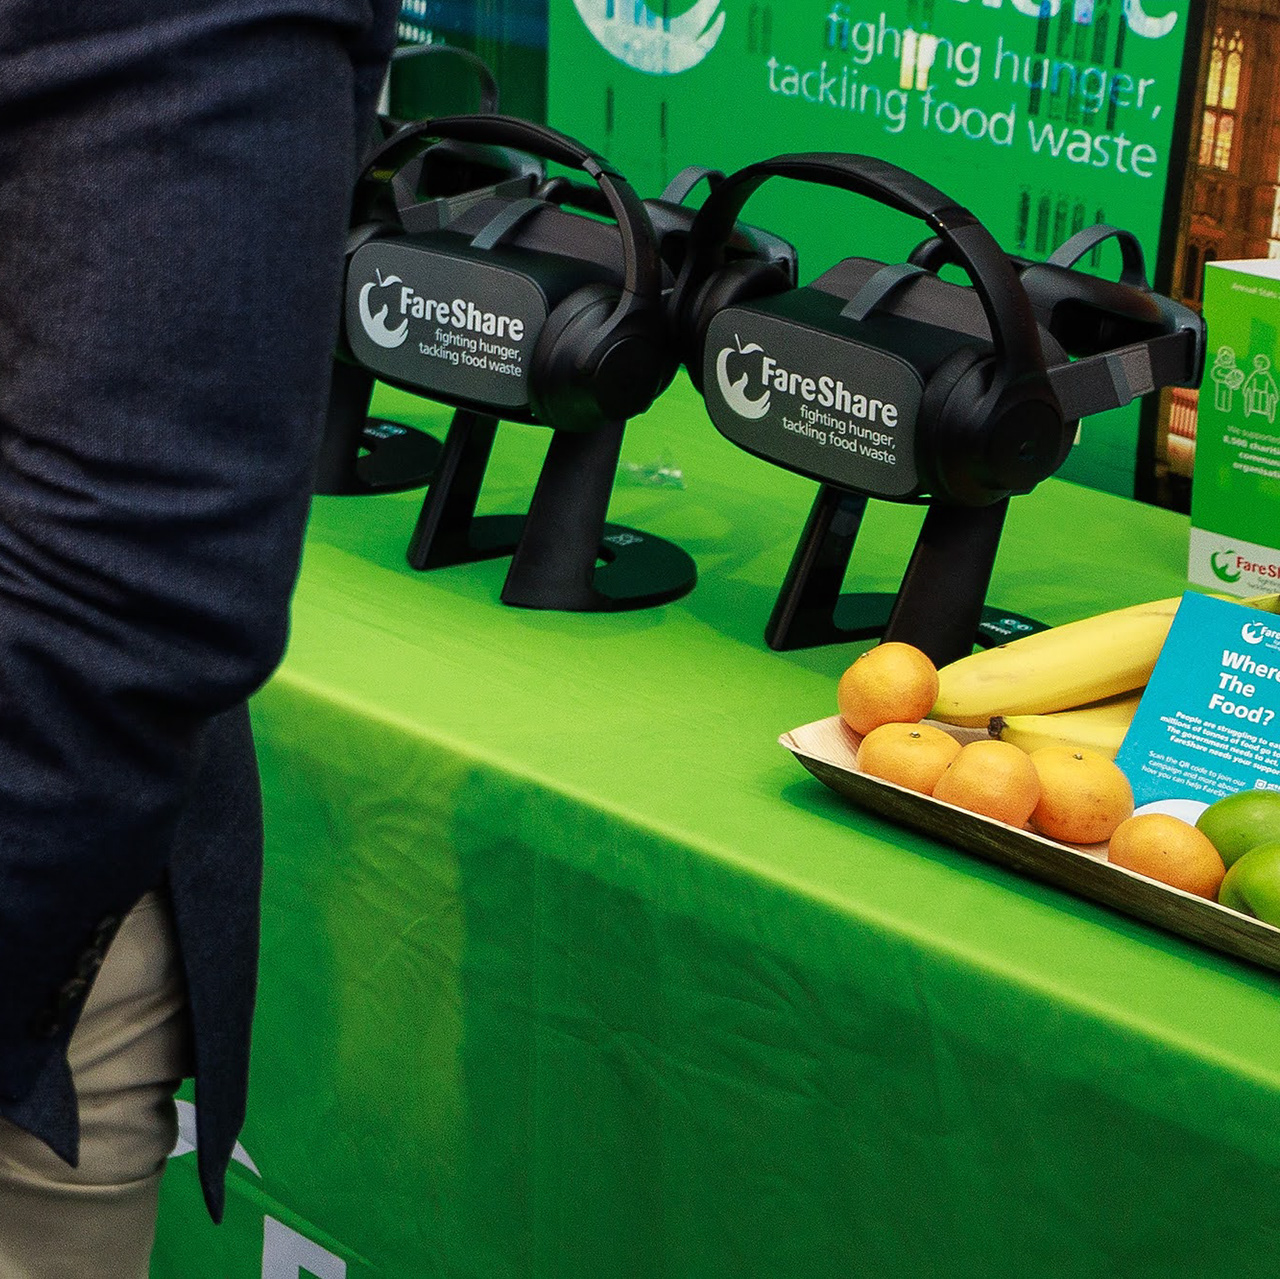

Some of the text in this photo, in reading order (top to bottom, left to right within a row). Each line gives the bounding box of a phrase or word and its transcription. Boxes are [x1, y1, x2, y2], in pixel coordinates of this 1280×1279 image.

[995, 37, 1162, 119] hunger,
[767, 55, 1157, 179] tackling food waste
[400, 286, 524, 341] FareShare
[419, 342, 522, 377] tackling food waste
[435, 328, 522, 362] fighting hunger,
[761, 356, 898, 427] FareShare
[782, 416, 896, 465] tackling food waste
[800, 404, 897, 449] fighting hunger,
[1219, 672, 1255, 698] The
[1208, 693, 1275, 726] Food?
[1160, 715, 1191, 730] millions
[1192, 723, 1202, 733] of
[1202, 728, 1229, 742] tonnes
[1229, 737, 1240, 745] of
[1240, 739, 1260, 752] food
[1260, 746, 1271, 756] go
[1166, 725, 1279, 767] The government needs to act.
[1175, 711, 1202, 725] People
[1203, 719, 1216, 729] are
[1217, 722, 1258, 743] struggling
[1258, 737, 1268, 746] to
[1148, 750, 1246, 787] Scan the QR code to join our
[1170, 735, 1208, 752] FareShare
[1209, 748, 1232, 760] needs
[1232, 756, 1252, 766] your
[1141, 765, 1228, 798] how you can help FareSh
[1148, 760, 1182, 775] campaign
[1183, 771, 1197, 779] and
[1198, 776, 1217, 786] more
